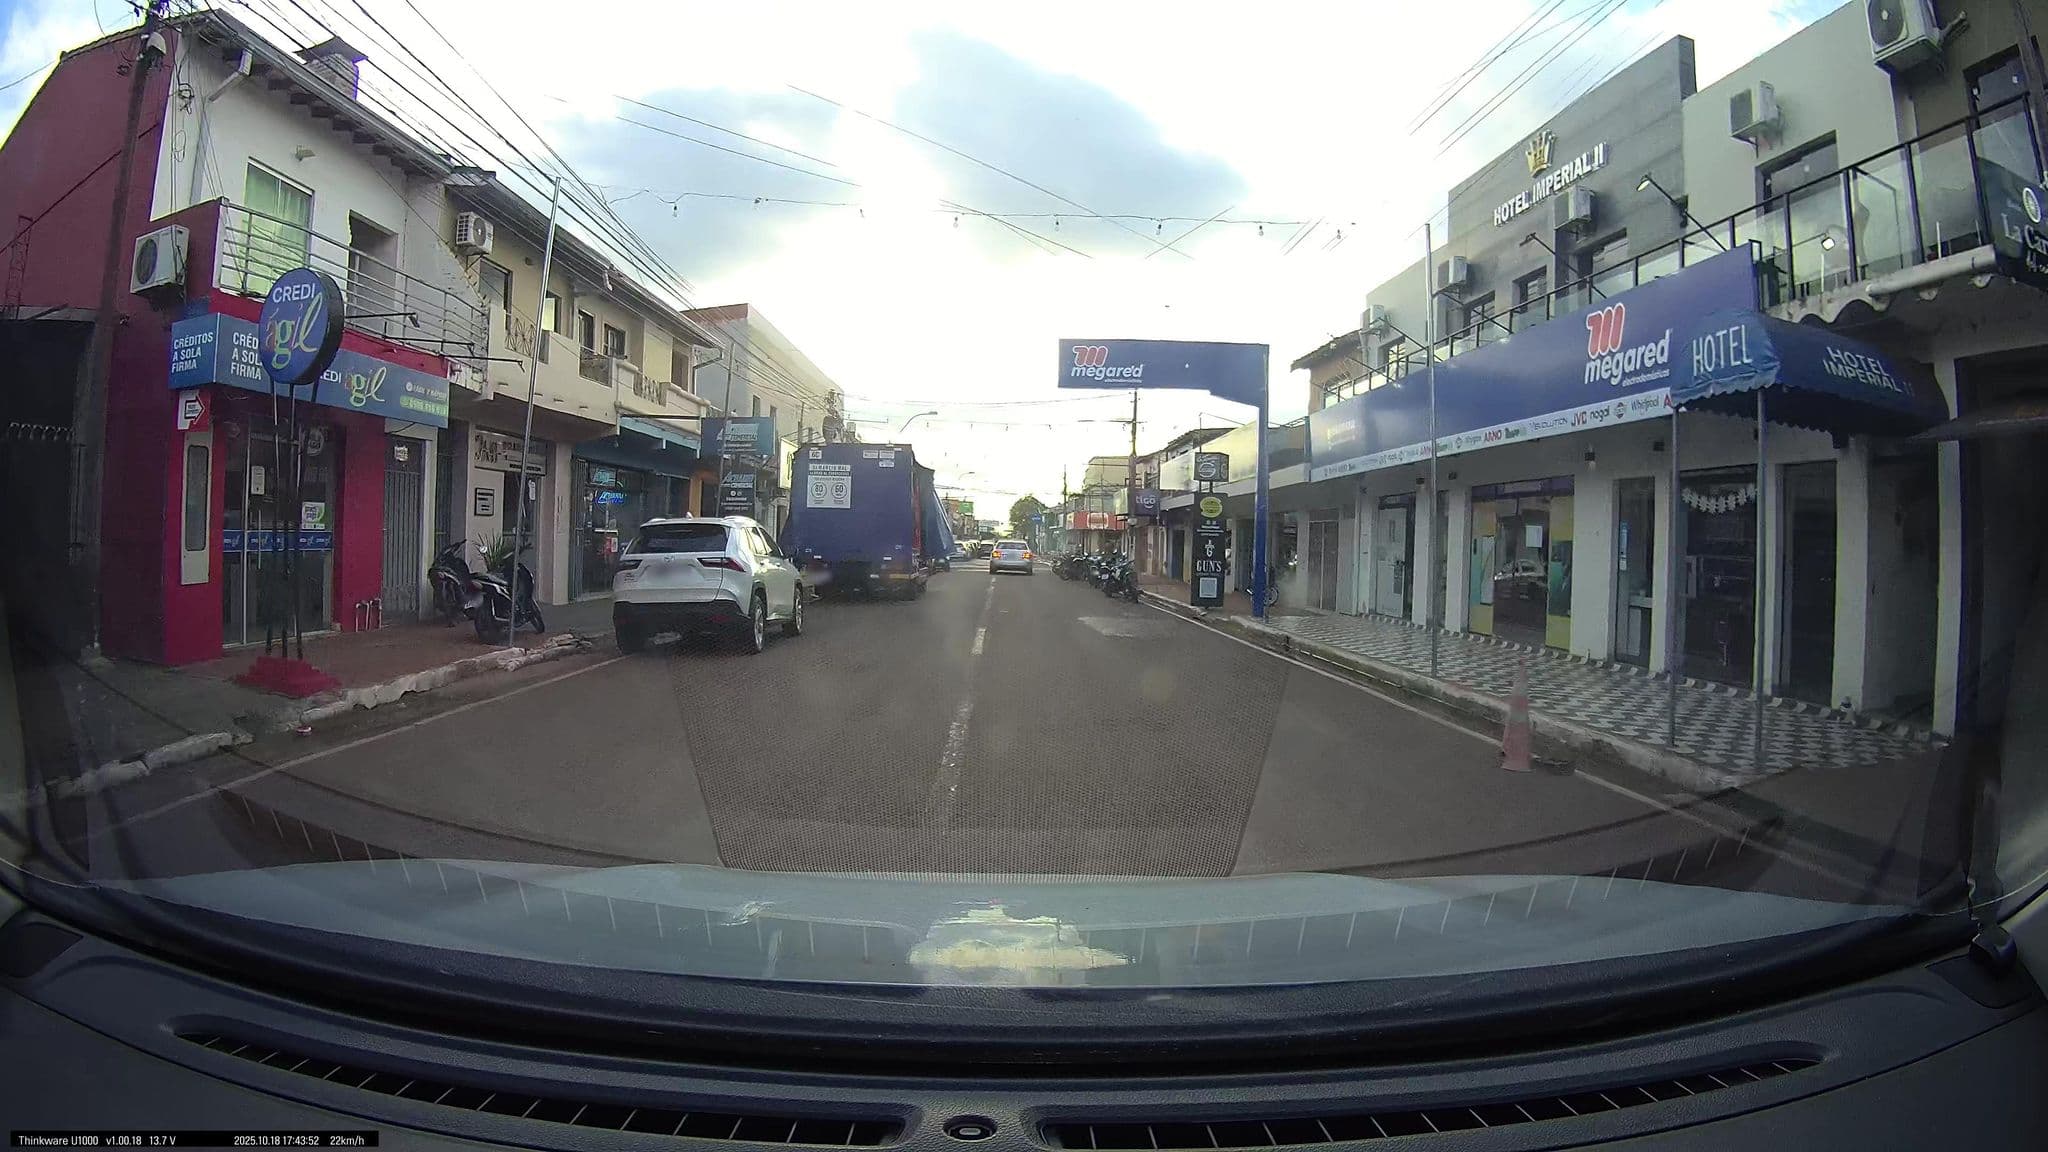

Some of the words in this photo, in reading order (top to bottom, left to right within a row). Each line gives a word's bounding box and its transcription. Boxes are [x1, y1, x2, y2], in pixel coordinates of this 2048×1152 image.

[1494, 190, 1529, 226] HOTEL
[1532, 152, 1591, 204] IMPERIAL
[272, 283, 316, 303] CREDI
[173, 332, 214, 350] CRÉDITOS
[233, 332, 259, 349] CRÉD
[173, 351, 180, 362] A
[180, 347, 201, 361] SOLA
[232, 348, 239, 361] A
[241, 350, 263, 365] SOL
[1584, 328, 1671, 385] megared
[1692, 324, 1752, 377] HOTEL
[172, 359, 197, 373] FIRMA
[1826, 346, 1890, 376] HOTEL
[231, 364, 261, 381] FIRMA
[321, 369, 342, 384] EDI
[1071, 364, 1143, 380] megared
[1823, 359, 1903, 393] IMPERIAL
[1571, 410, 1587, 427] JVC
